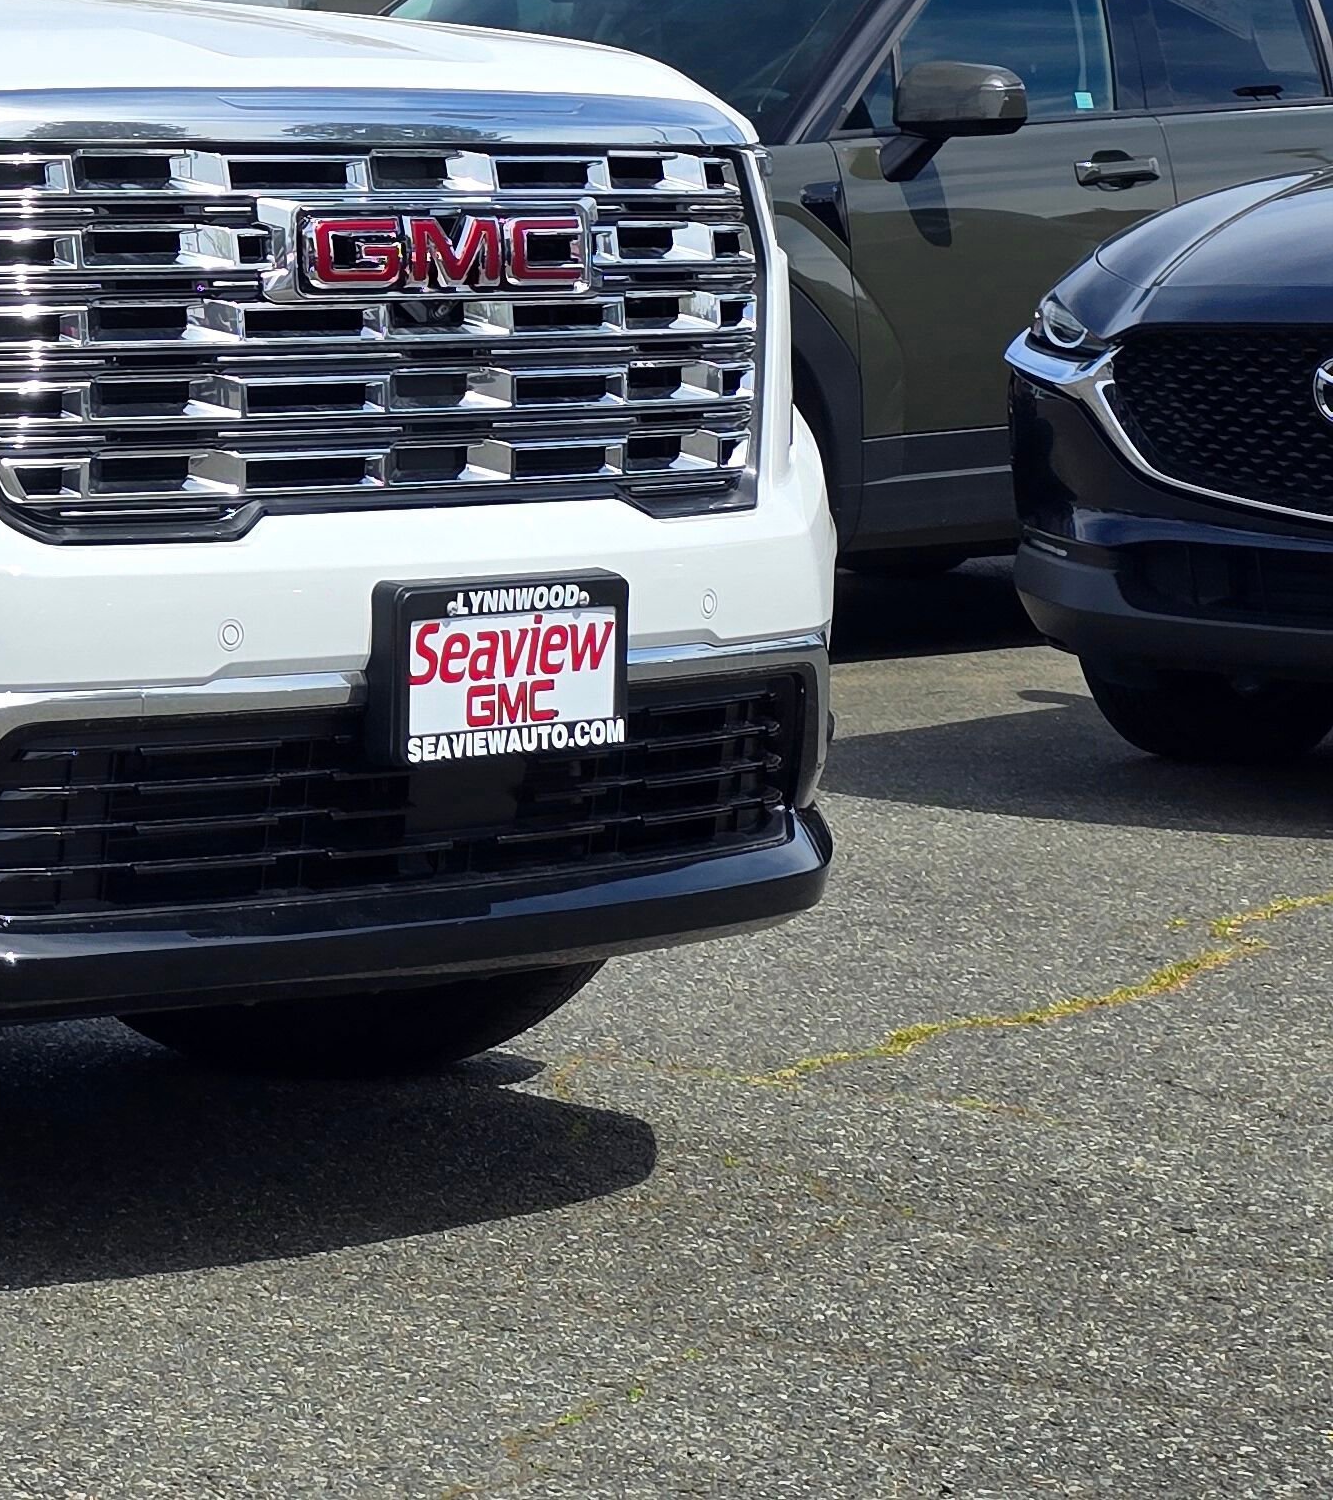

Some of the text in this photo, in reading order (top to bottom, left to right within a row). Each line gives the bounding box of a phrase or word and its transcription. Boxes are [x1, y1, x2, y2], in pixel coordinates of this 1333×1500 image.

[312, 215, 588, 288] GMC
[457, 584, 580, 615] LYNNWOOD
[409, 614, 614, 686] Seaview
[466, 679, 560, 728] GMC
[407, 716, 625, 763] SEAVIEWAUTO.COM
